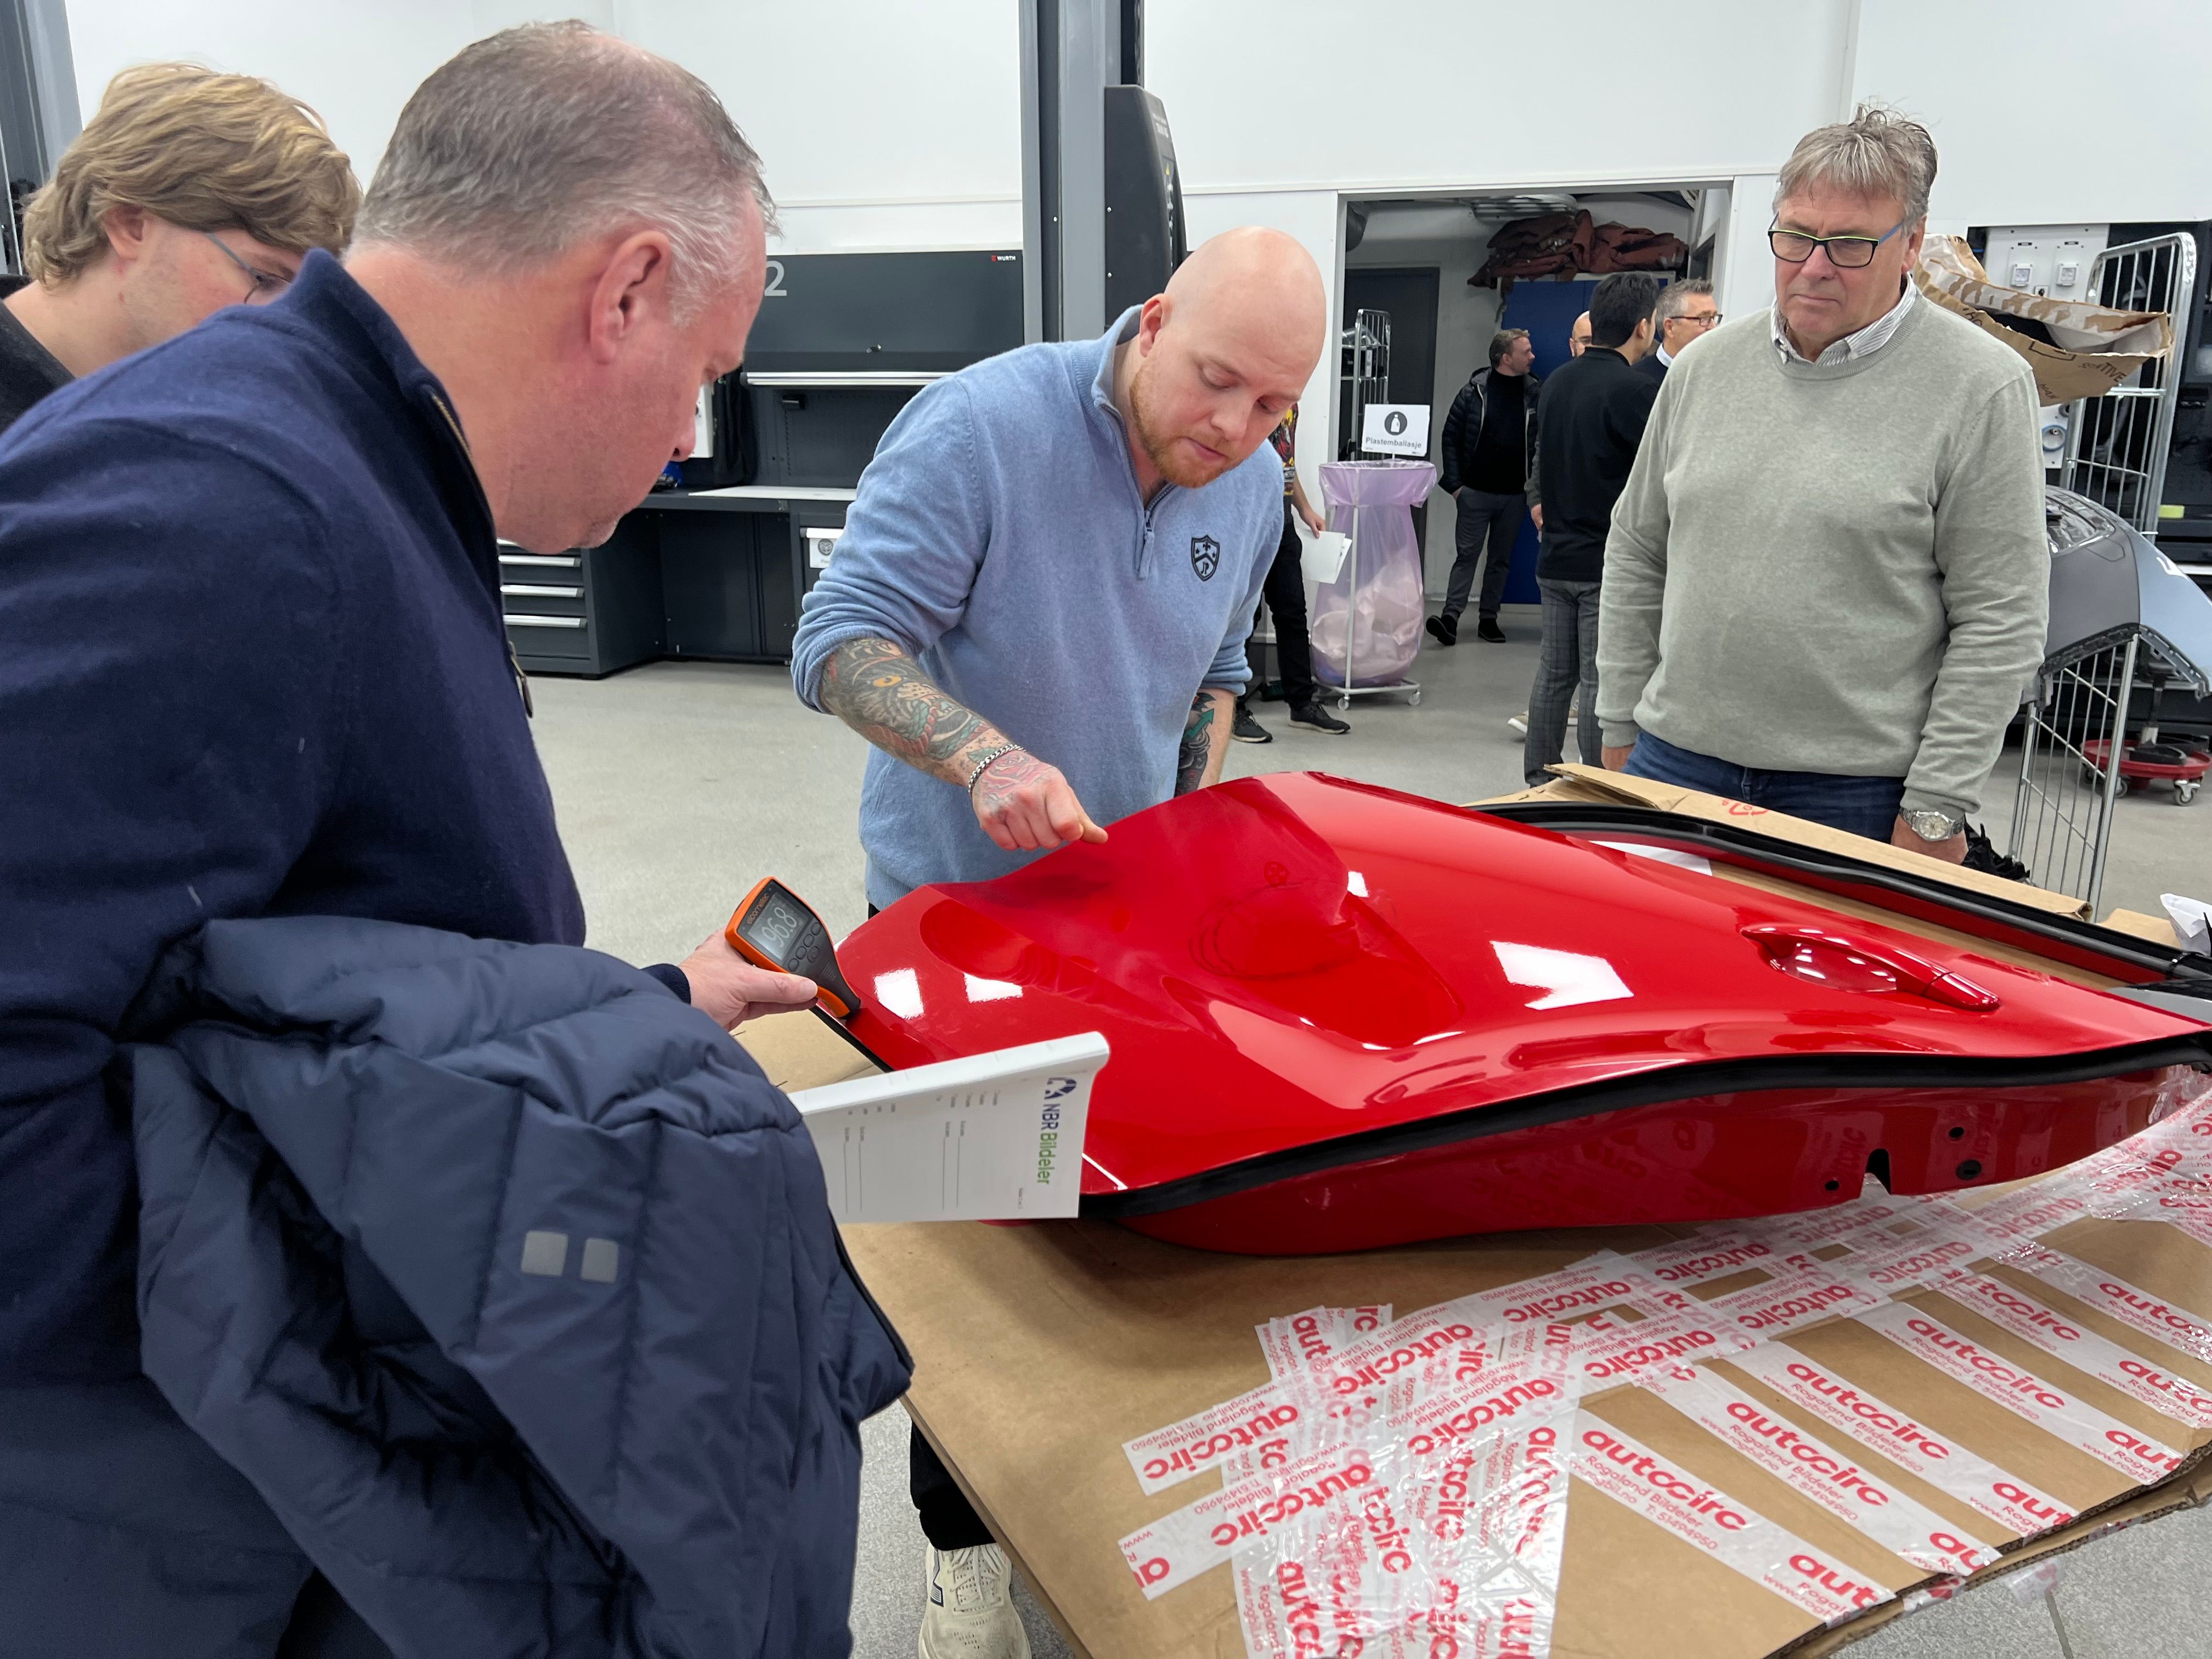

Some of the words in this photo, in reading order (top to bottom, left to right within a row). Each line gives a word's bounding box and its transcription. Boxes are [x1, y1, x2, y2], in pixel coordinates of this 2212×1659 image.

[764, 261, 787, 296] 2
[1366, 437, 1422, 449] Plastemballasje
[762, 907, 797, 947] 96.8
[1041, 1103, 1059, 1131] NBR
[1037, 1132, 1058, 1185] Bildeler
[1655, 1244, 1770, 1280] autocirc
[1503, 1281, 1632, 1323] autocirc
[1737, 1285, 1853, 1329] autocirc
[1340, 1340, 1384, 1368] Bildeler
[1385, 1318, 1440, 1350] Rogaland
[1584, 1330, 1716, 1378] autocirc
[1333, 1324, 1474, 1395] autocirc
[1907, 1319, 2065, 1409] autocirc
[1912, 1337, 1974, 1374] Rogaland
[1974, 1374, 2027, 1403] Bildeler
[1203, 1384, 1278, 1421] www.rogbil.no
[1460, 1373, 1518, 1403] Rogaland
[1207, 1400, 1265, 1431] Rogaland
[1407, 1379, 1555, 1455] autocirc
[1414, 1401, 1461, 1426] Bildeler
[1786, 1363, 1949, 1459] autocirc
[1791, 1383, 1856, 1422] Rogaland
[1856, 1422, 1909, 1453] Bildeler
[1143, 1404, 1299, 1479] autocirc
[1158, 1427, 1205, 1451] Bildeler
[1726, 1402, 1889, 1506] autocirc
[1582, 1430, 1746, 1530] autocirc
[1730, 1424, 1793, 1466] Rogaland
[1792, 1465, 1844, 1501] Bildeler
[1211, 1464, 1372, 1547] autocirc
[1222, 1486, 1272, 1513] Bildeler
[1585, 1455, 1651, 1497] Rogaland
[1650, 1493, 1703, 1528] Bildeler
[1657, 1511, 1718, 1550] 51494950
